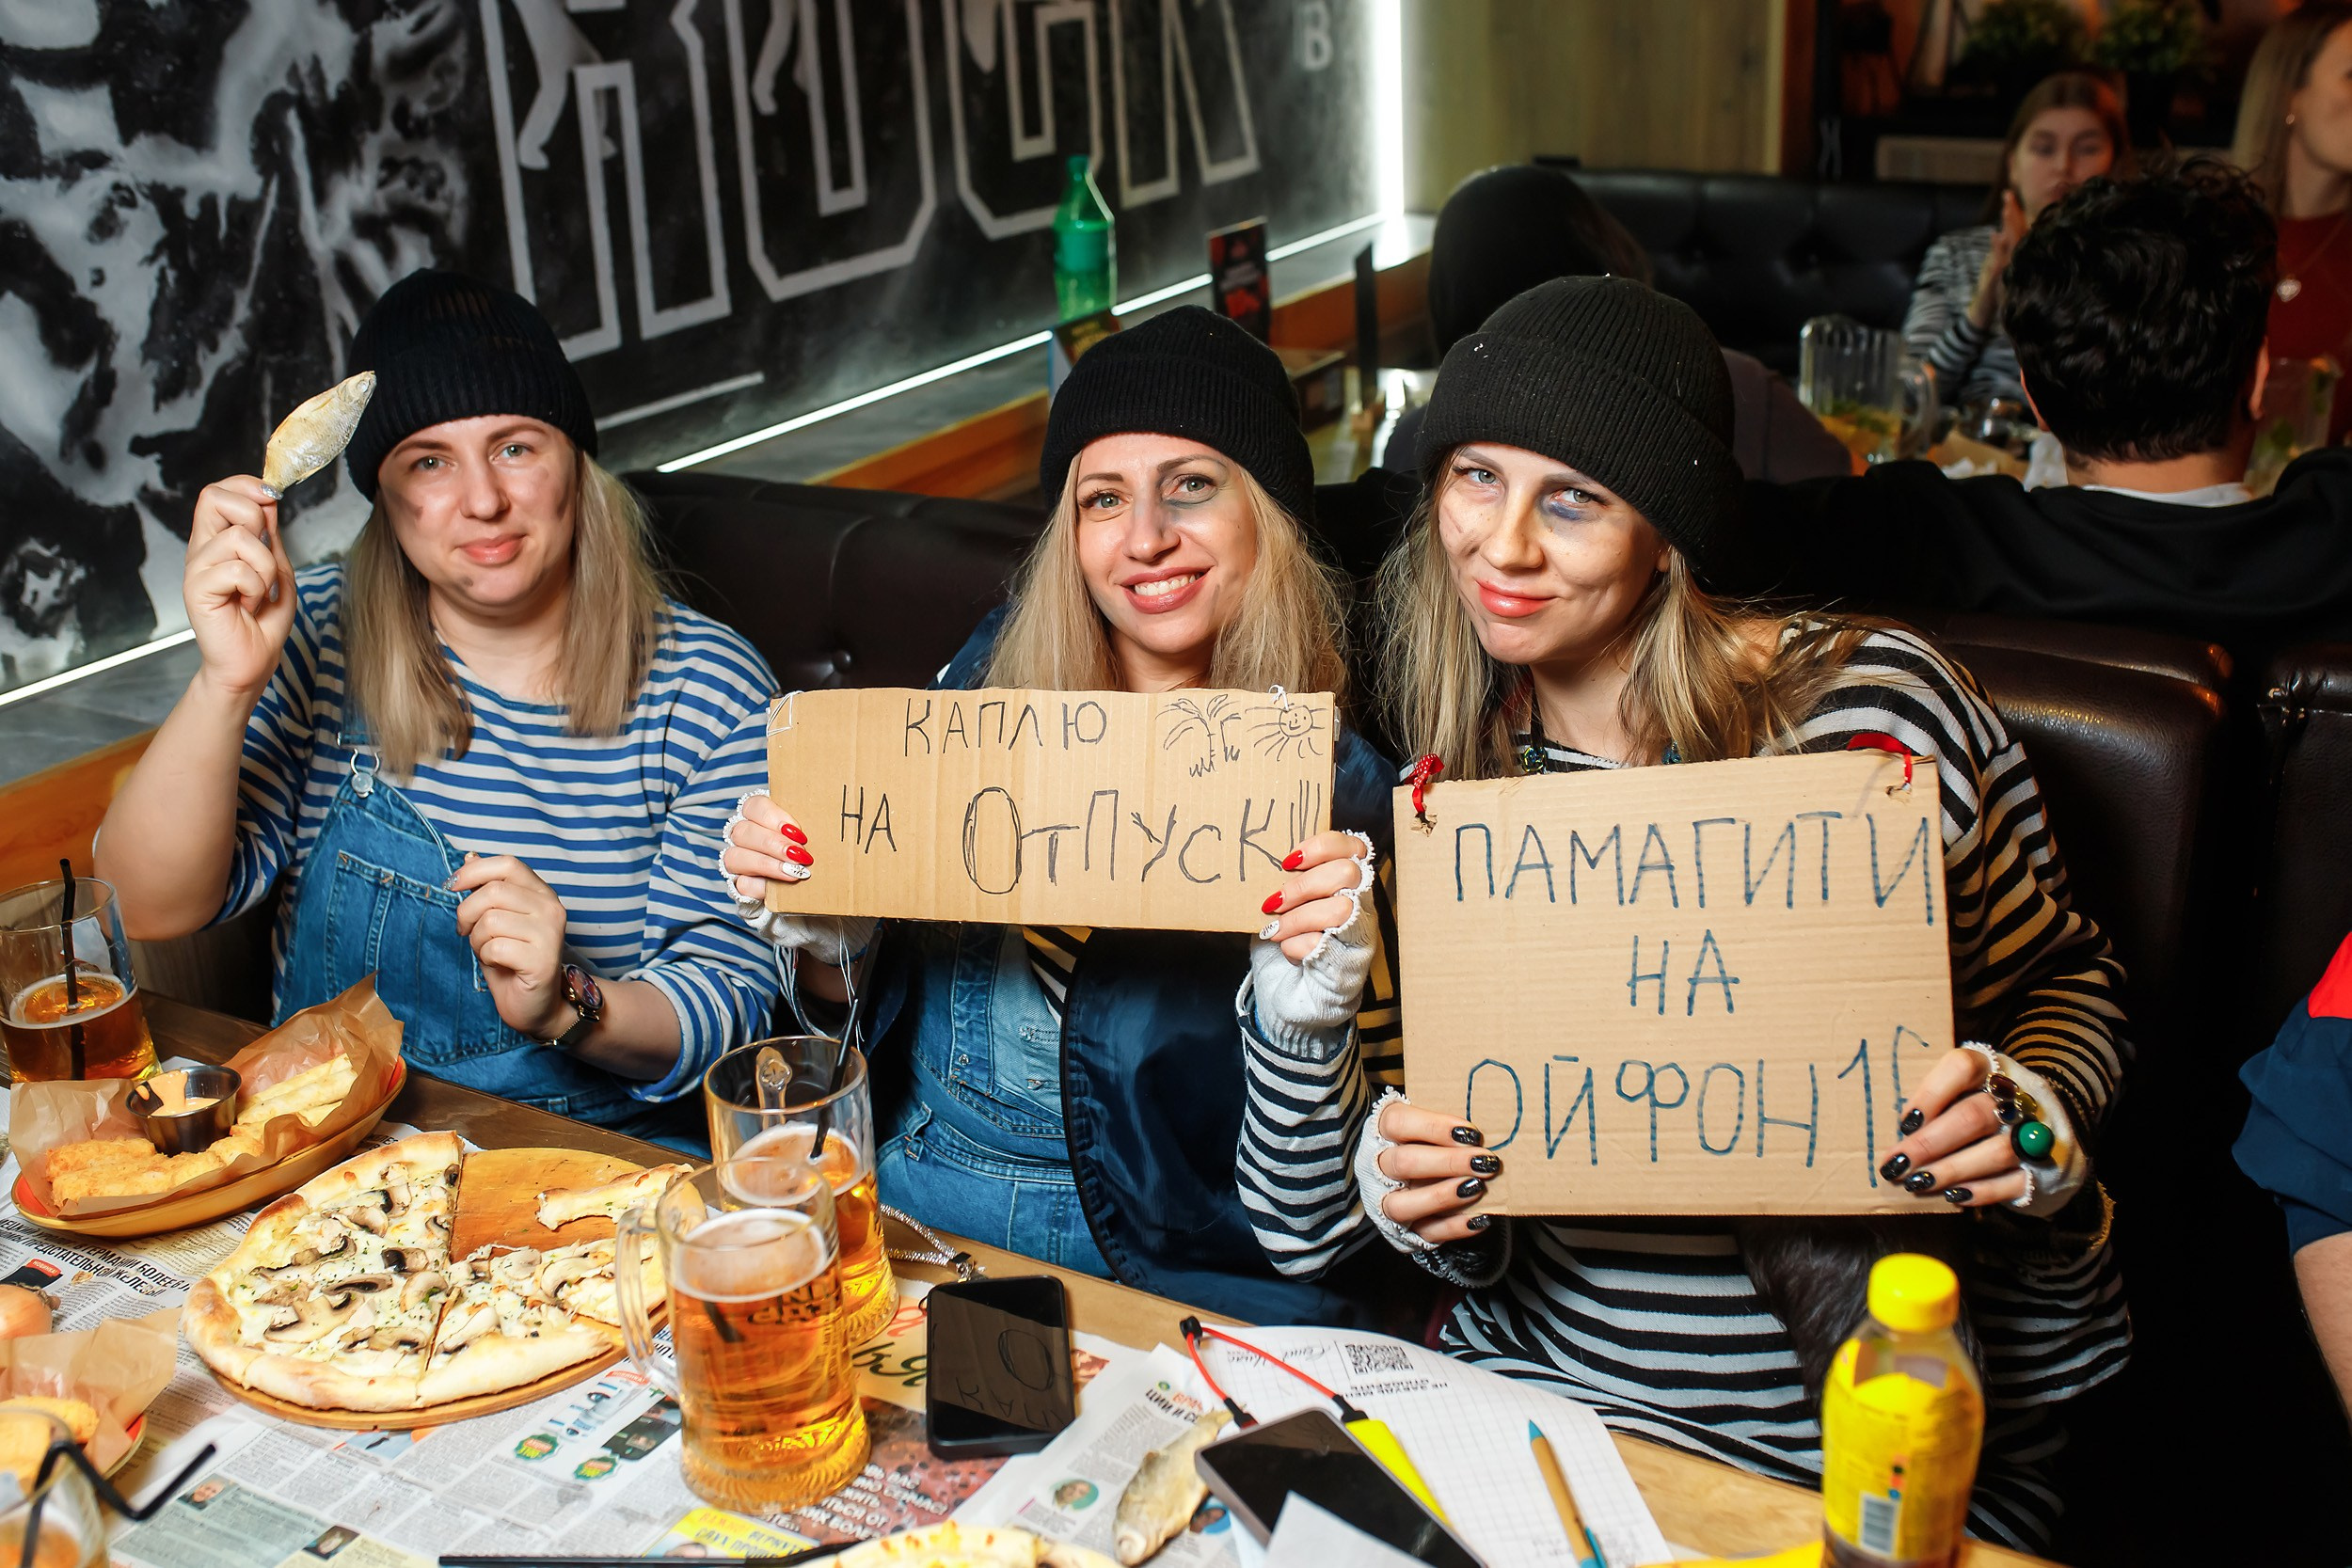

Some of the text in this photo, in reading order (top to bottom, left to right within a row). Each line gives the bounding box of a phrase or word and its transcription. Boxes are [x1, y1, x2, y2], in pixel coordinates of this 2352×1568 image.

[904, 697, 1106, 756] КАПЛЮ
[840, 784, 897, 853] НА
[1454, 811, 1934, 927] ПАМАГИТИ
[1626, 927, 1740, 1017] НА
